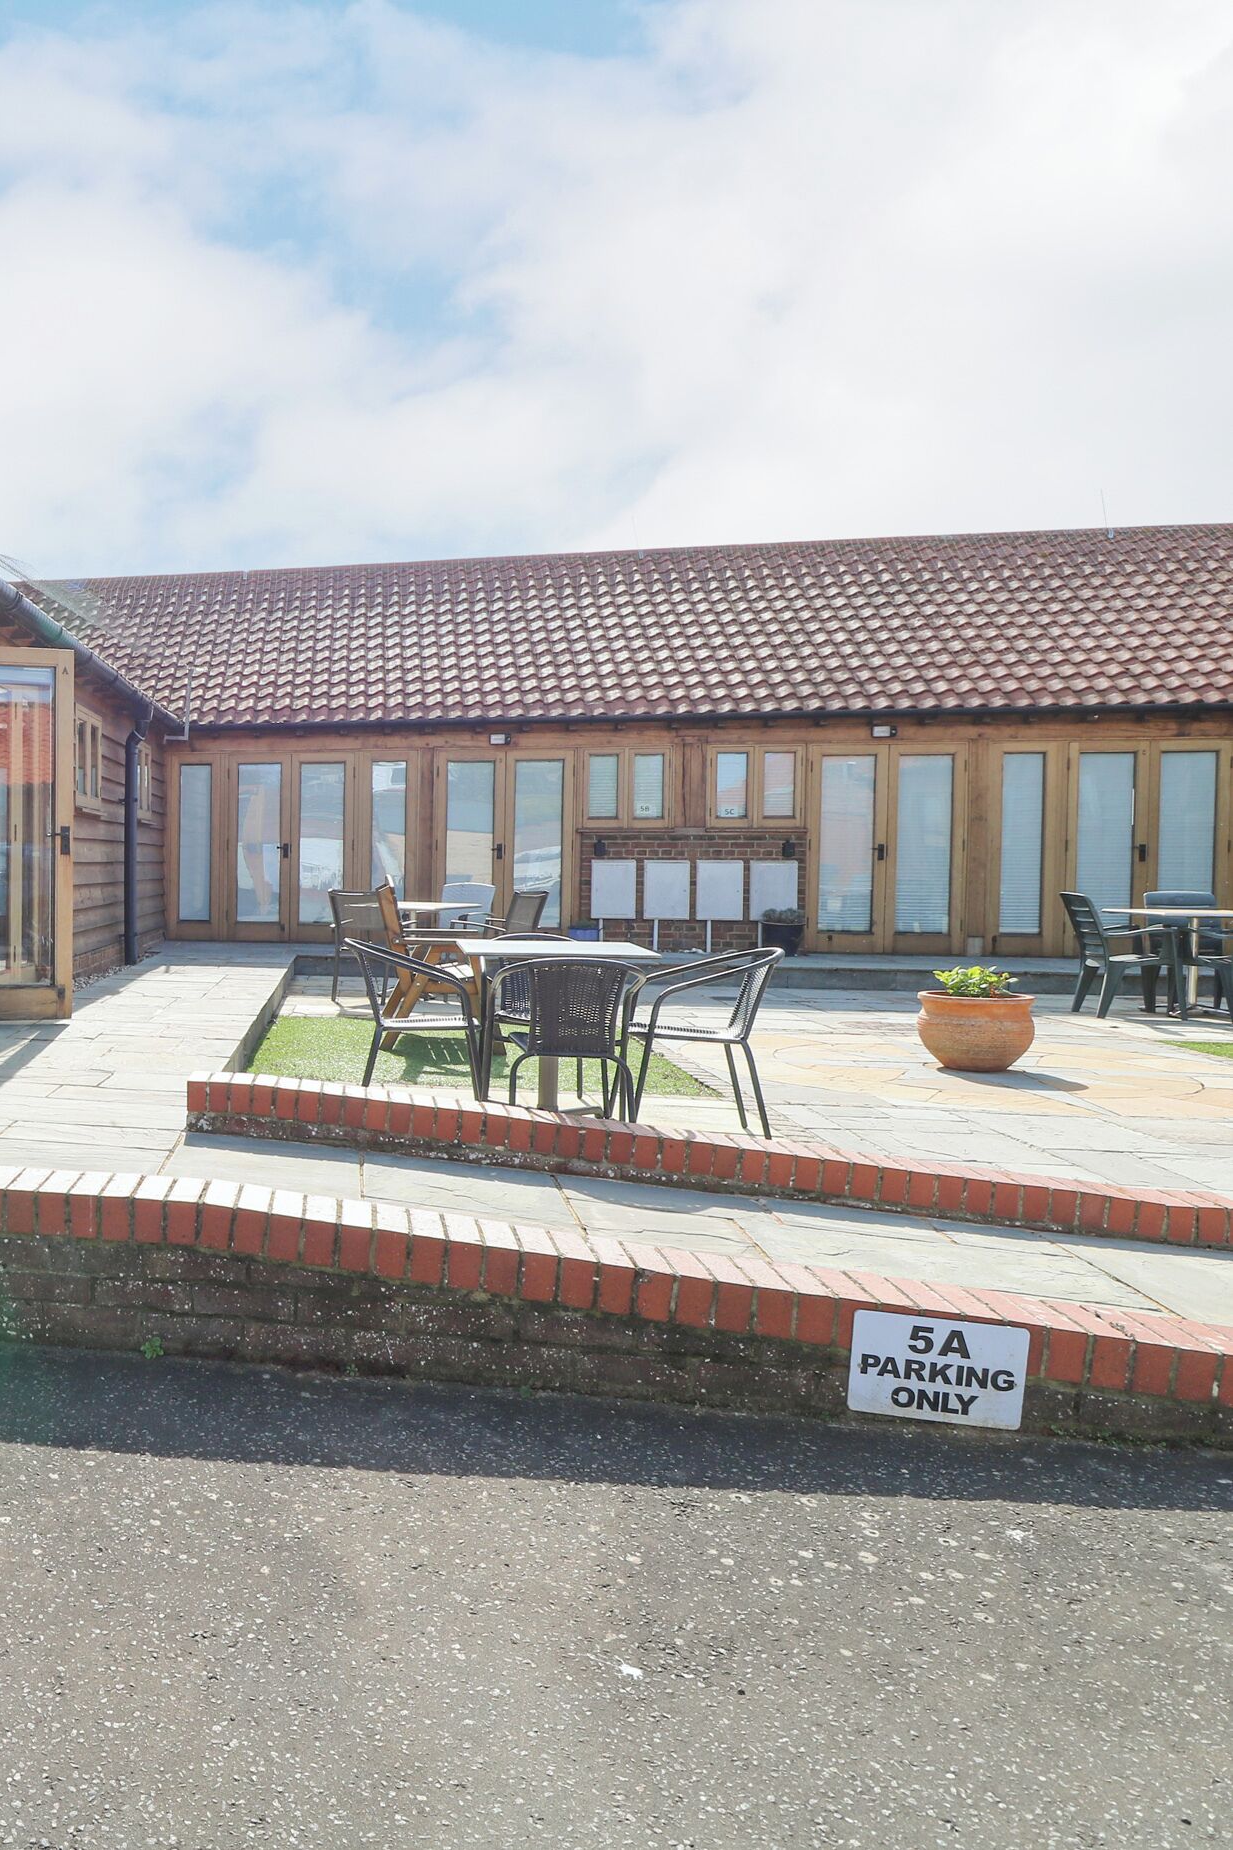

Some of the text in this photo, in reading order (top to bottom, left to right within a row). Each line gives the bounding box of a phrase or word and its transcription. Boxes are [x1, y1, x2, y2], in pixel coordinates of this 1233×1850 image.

[907, 1325, 971, 1360] 5A
[859, 1353, 1016, 1392] PARKING
[890, 1386, 979, 1416] ONLY
